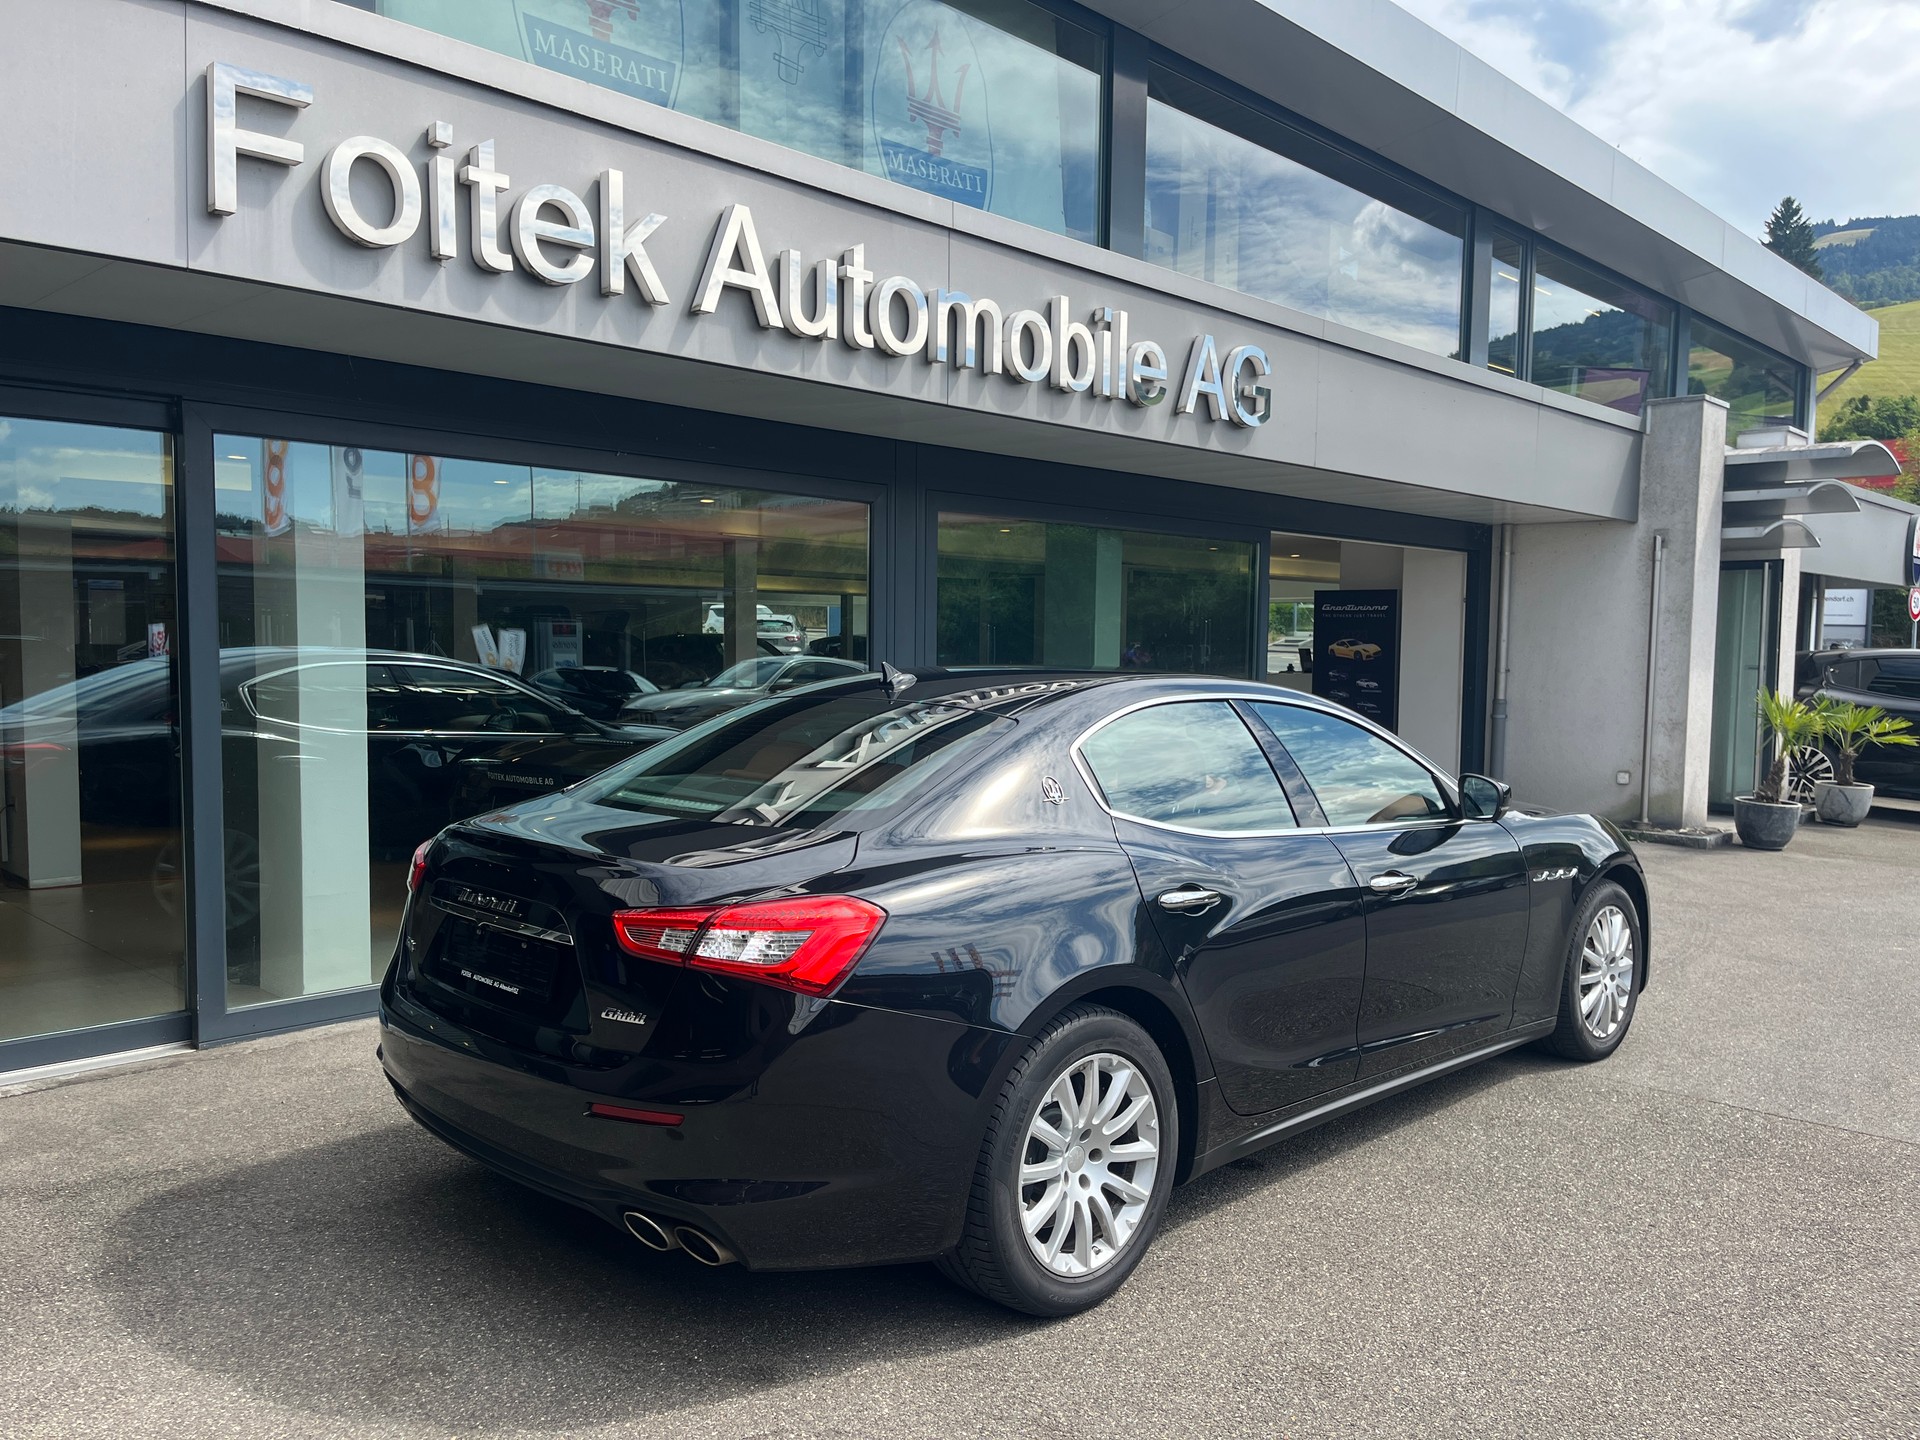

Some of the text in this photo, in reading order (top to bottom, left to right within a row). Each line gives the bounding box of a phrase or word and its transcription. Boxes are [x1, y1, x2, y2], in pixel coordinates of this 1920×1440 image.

[533, 29, 668, 93] MASERATI
[887, 149, 983, 194] MASERATI
[206, 61, 1272, 429] Foitek Automobile AG
[487, 771, 554, 786] FOITEK AUTOMOBILE AG
[472, 974, 494, 986] AUTOMOBILE
[601, 1006, 647, 1025] Ghibli
